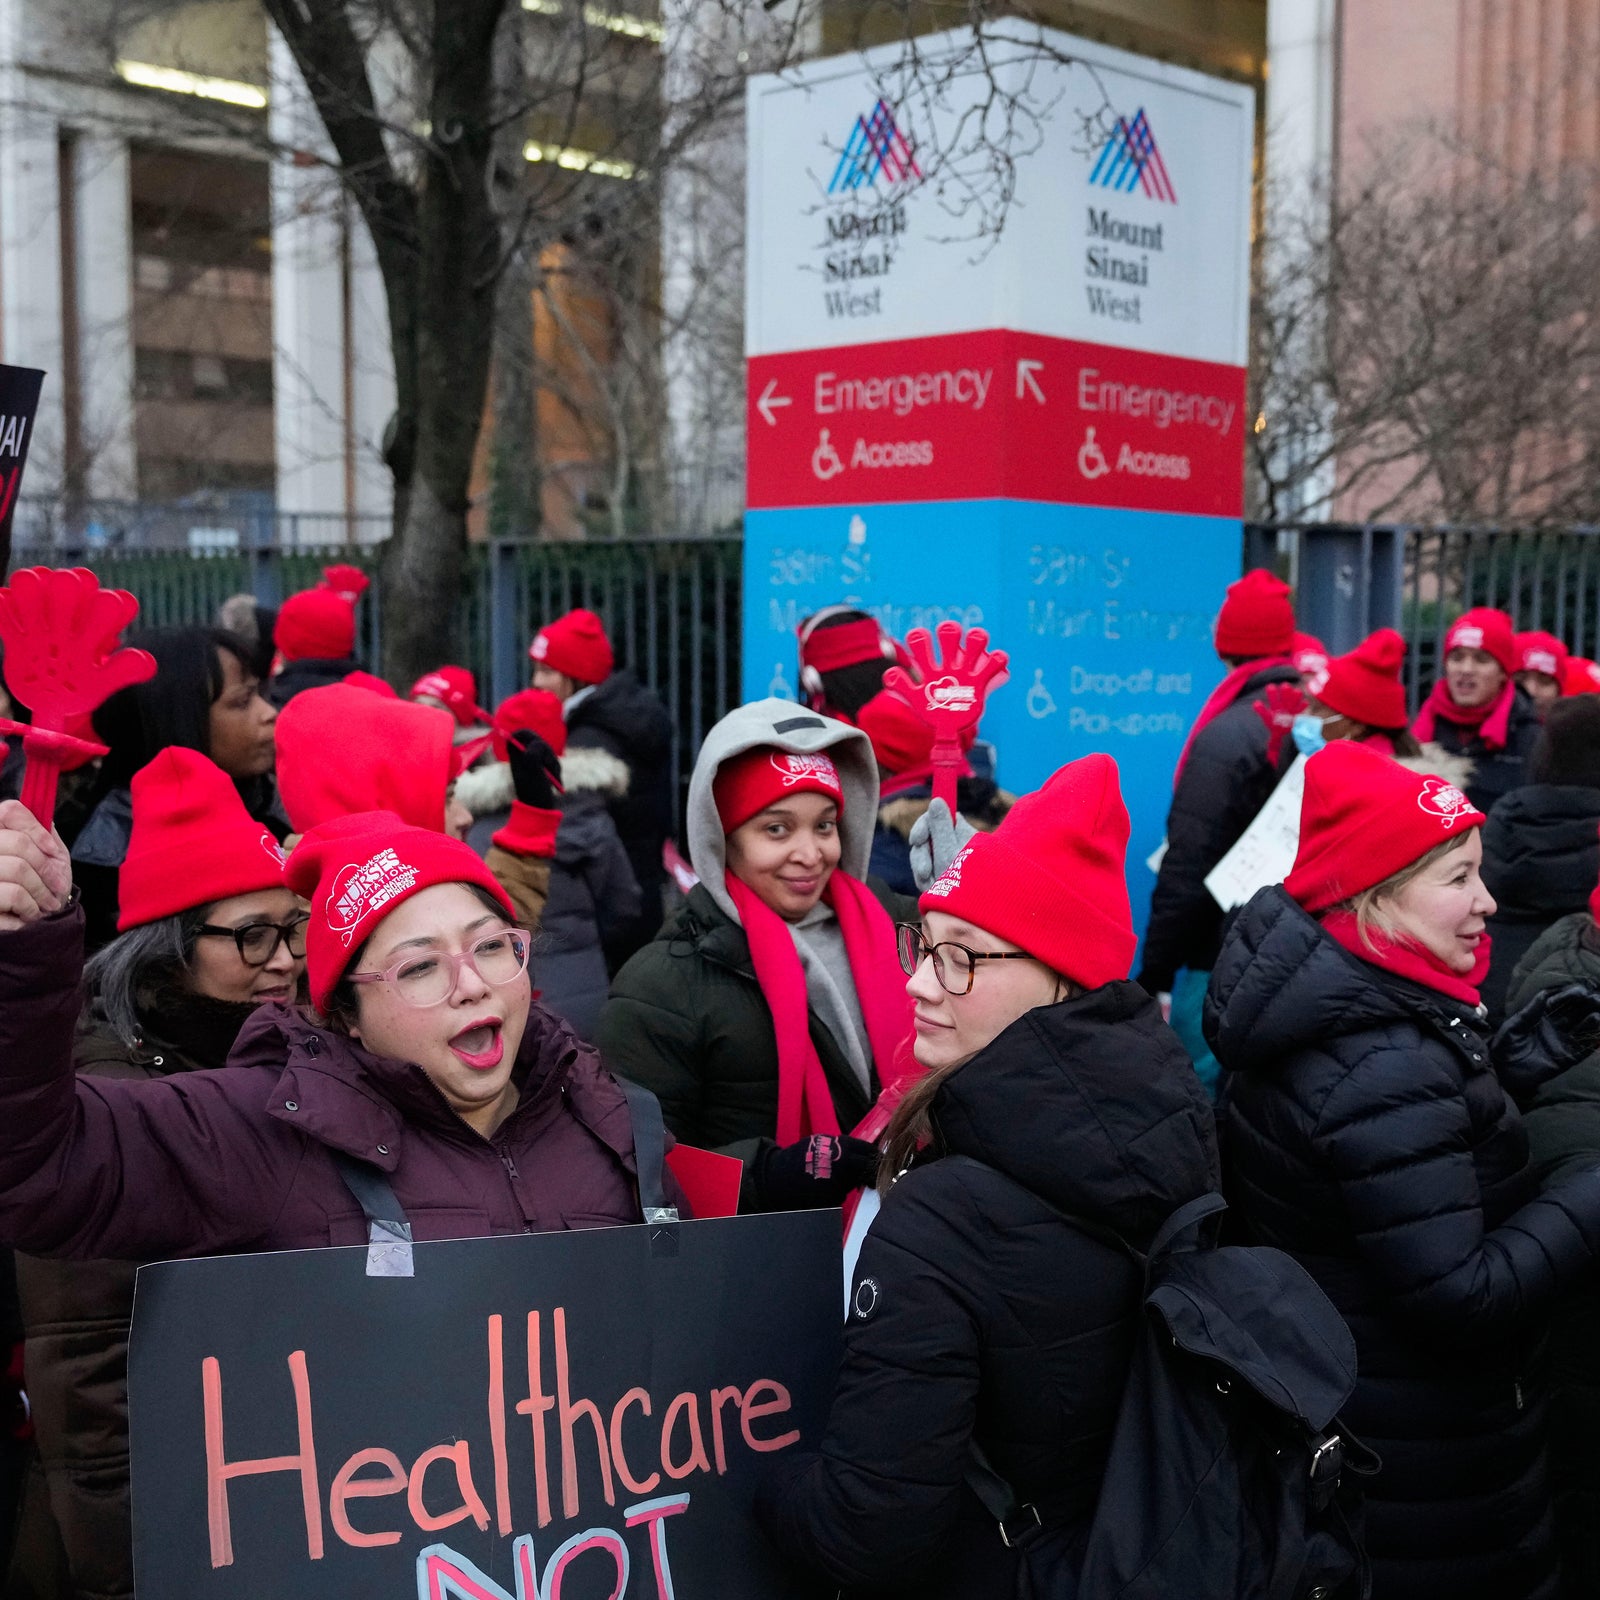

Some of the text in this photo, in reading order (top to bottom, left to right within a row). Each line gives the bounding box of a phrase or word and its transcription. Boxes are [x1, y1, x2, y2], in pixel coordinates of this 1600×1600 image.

[826, 205, 906, 240] Mount
[1085, 205, 1164, 252] Mount
[824, 243, 890, 283] Sinai
[1084, 245, 1148, 287] Sinai
[823, 287, 882, 318] West
[1084, 285, 1142, 324] West
[814, 368, 994, 417] Emergency
[1079, 367, 1237, 437] Emergency
[851, 437, 934, 470] Access
[1116, 442, 1192, 480] Access
[1070, 665, 1193, 697] Drop-off and
[334, 852, 400, 918] NURSES
[344, 847, 395, 889] New York State
[384, 867, 420, 890] NATIONAL
[388, 880, 416, 898] UNITED
[202, 1307, 801, 1568] Healthcare
[416, 1493, 691, 1600] NOT
